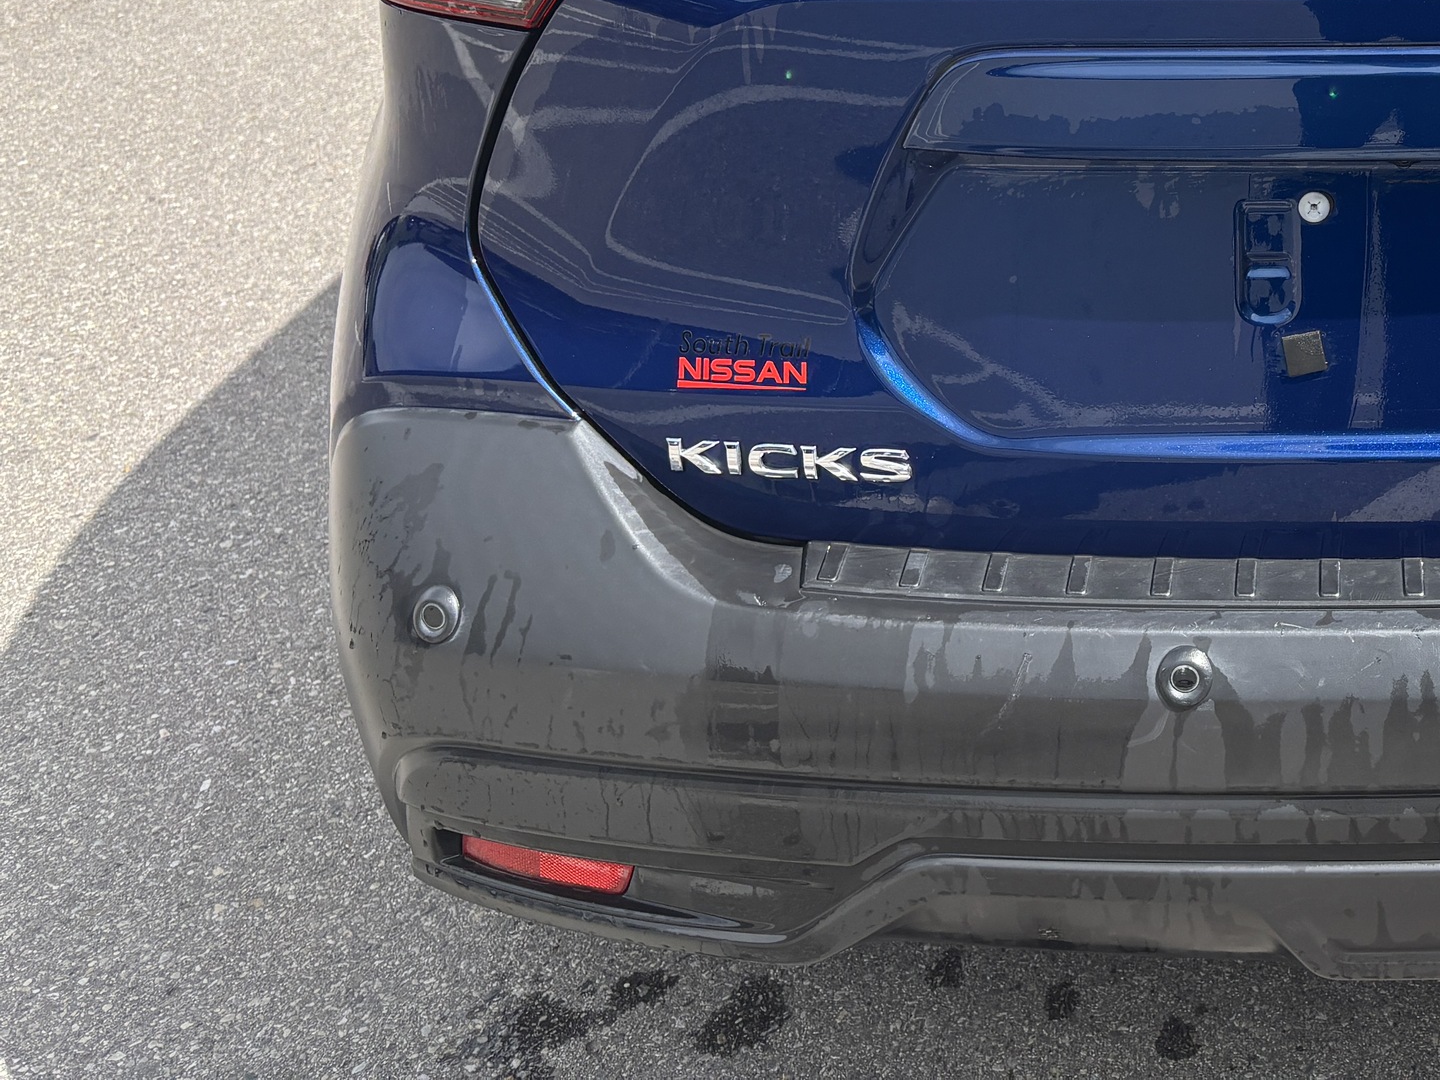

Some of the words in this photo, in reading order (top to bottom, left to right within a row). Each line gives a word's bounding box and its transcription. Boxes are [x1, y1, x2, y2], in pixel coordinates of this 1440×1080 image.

[680, 329, 749, 357] South
[758, 333, 811, 358] Trail
[678, 356, 807, 384] NISSAN
[665, 437, 913, 483] KICKS
